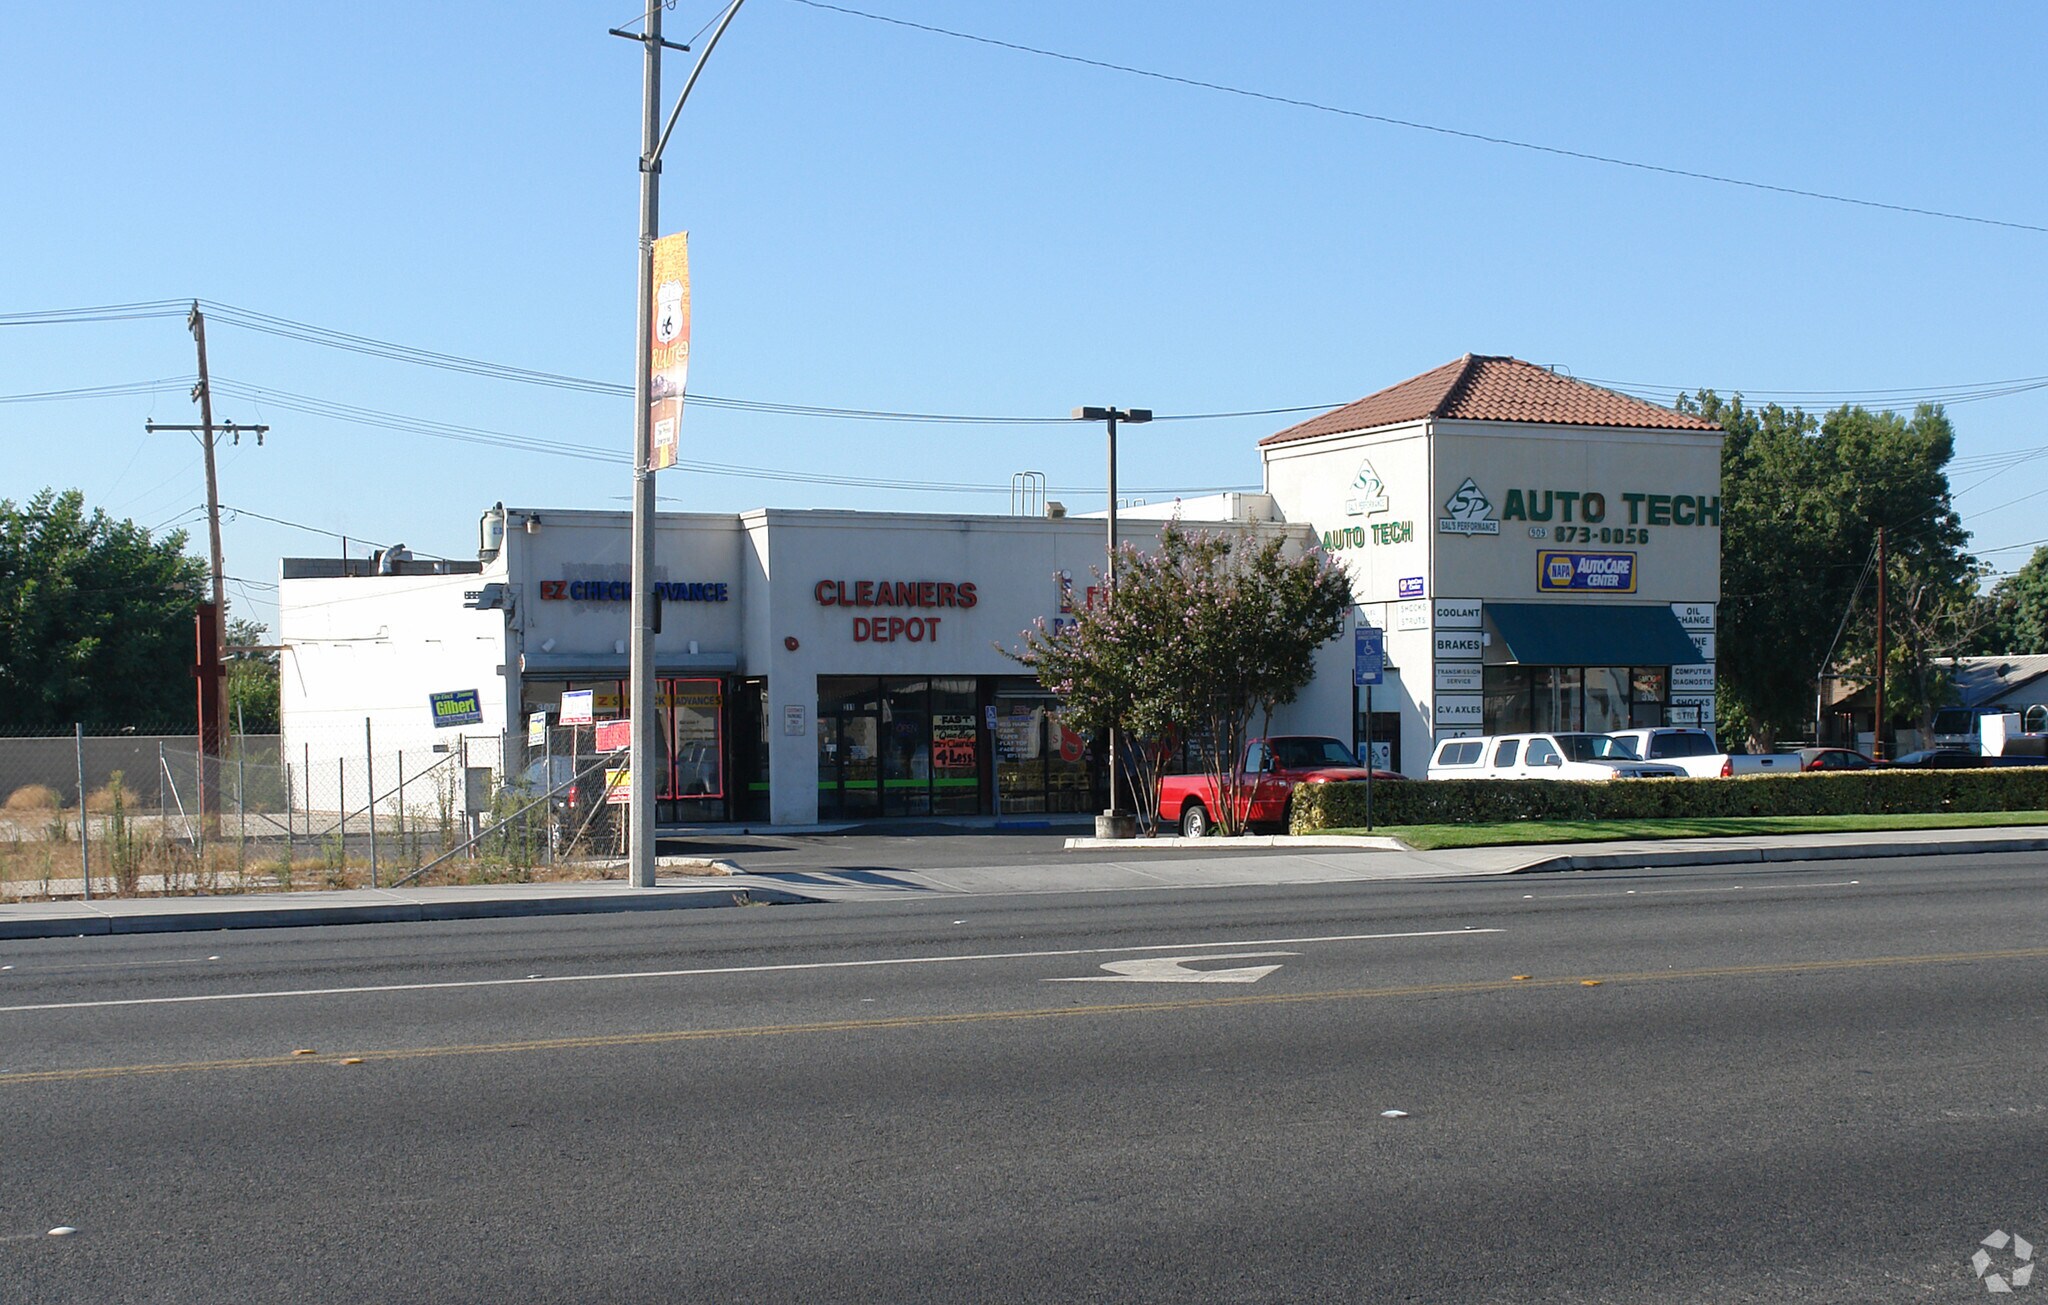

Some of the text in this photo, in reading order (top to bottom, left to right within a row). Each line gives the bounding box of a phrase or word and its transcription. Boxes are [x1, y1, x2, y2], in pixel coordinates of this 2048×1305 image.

[1452, 486, 1489, 518] SP
[1503, 488, 1720, 527] AUTO TECH
[1457, 521, 1496, 532] PERFORMANCE
[1322, 520, 1414, 551] AUTO TECH
[1530, 526, 1649, 544] 909 873-0056
[1551, 563, 1571, 578] NAPA
[1587, 574, 1619, 587] CENTER
[540, 580, 569, 600] EZ
[654, 581, 729, 601] DVANCE
[815, 579, 978, 608] CLEANERS
[1437, 608, 1480, 617] COOLANT
[1686, 607, 1700, 616] OIL
[853, 617, 942, 643] DEPOT
[1437, 640, 1480, 650] BRAKES
[435, 698, 476, 716] Gilbert
[1437, 705, 1481, 714] C.V. AXLES
[1676, 698, 1711, 706] SHOCKS
[942, 716, 970, 724] FAST
[936, 749, 948, 765] 4
